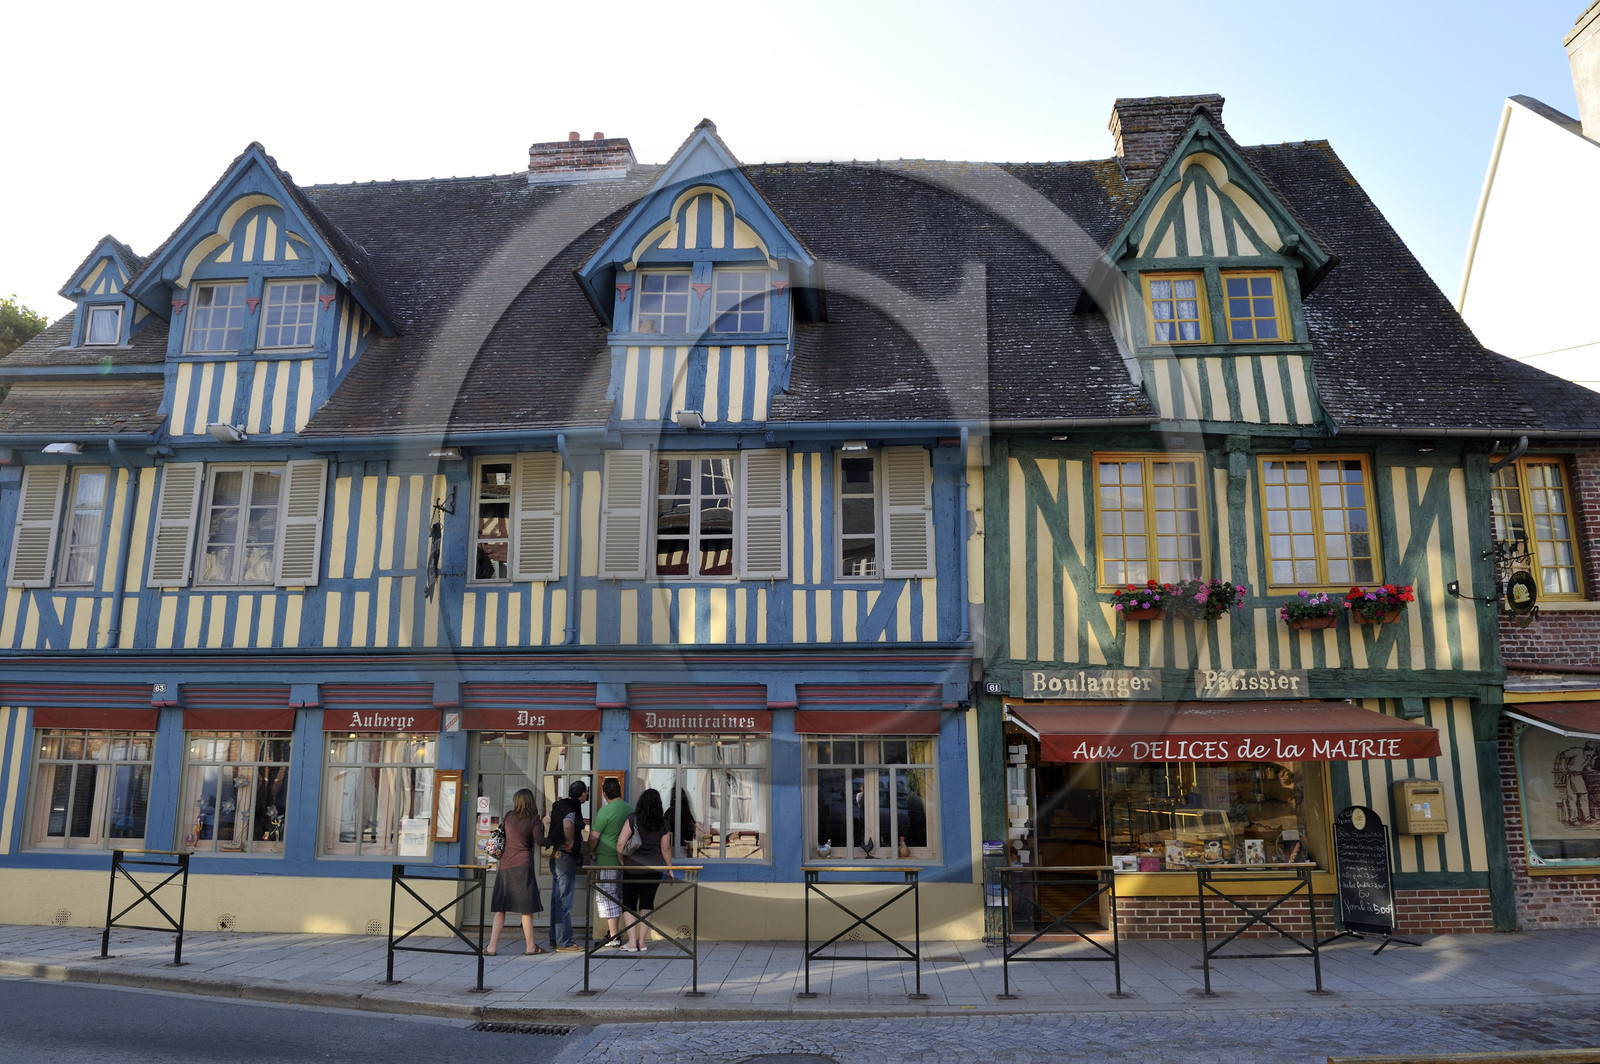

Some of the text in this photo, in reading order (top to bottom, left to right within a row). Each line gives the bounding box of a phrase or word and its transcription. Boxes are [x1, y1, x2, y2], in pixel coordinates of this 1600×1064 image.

[1032, 671, 1153, 697] Boulanger
[1202, 669, 1301, 690] Pâtissier
[349, 711, 415, 731] Auberge
[517, 711, 546, 727] Des
[645, 712, 756, 729] Dominicaines
[1072, 738, 1403, 760] Aux DELICES de la MAIRIE
